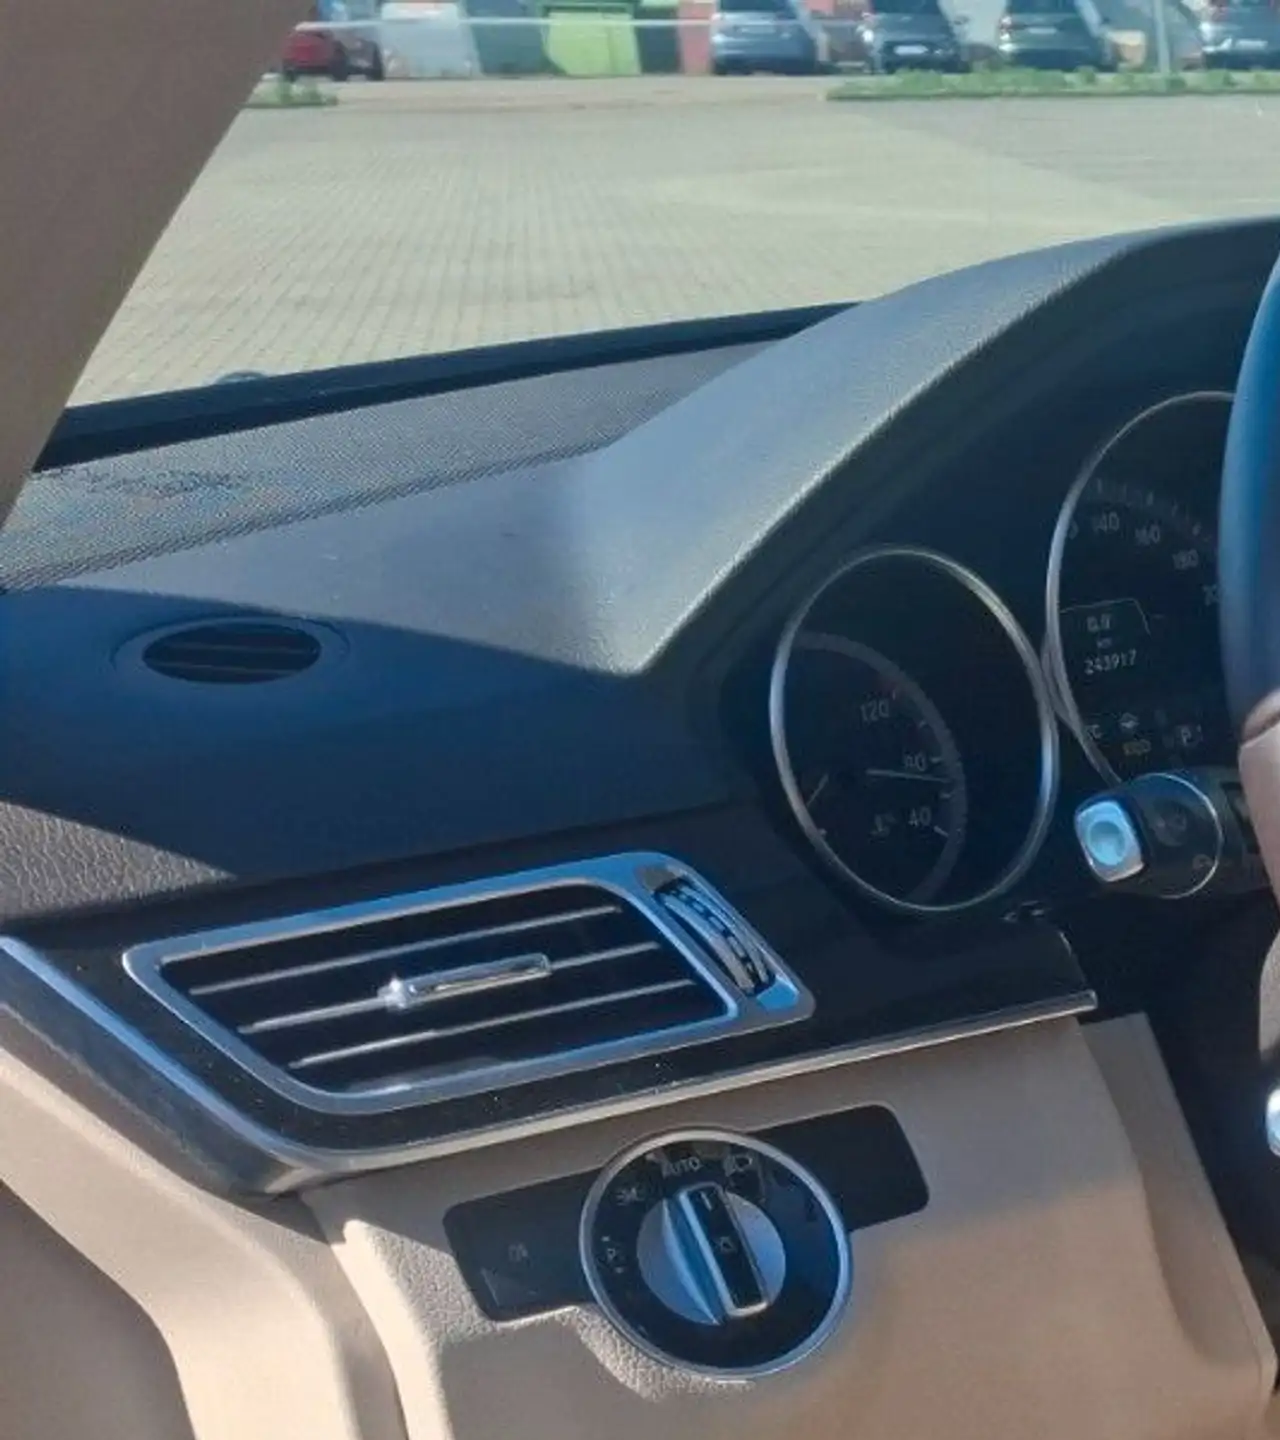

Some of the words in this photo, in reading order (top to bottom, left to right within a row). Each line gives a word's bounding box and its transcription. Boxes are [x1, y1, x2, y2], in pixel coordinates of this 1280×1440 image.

[859, 698, 890, 722] 120
[907, 806, 932, 828] 40
[661, 1156, 702, 1180] AUTO
